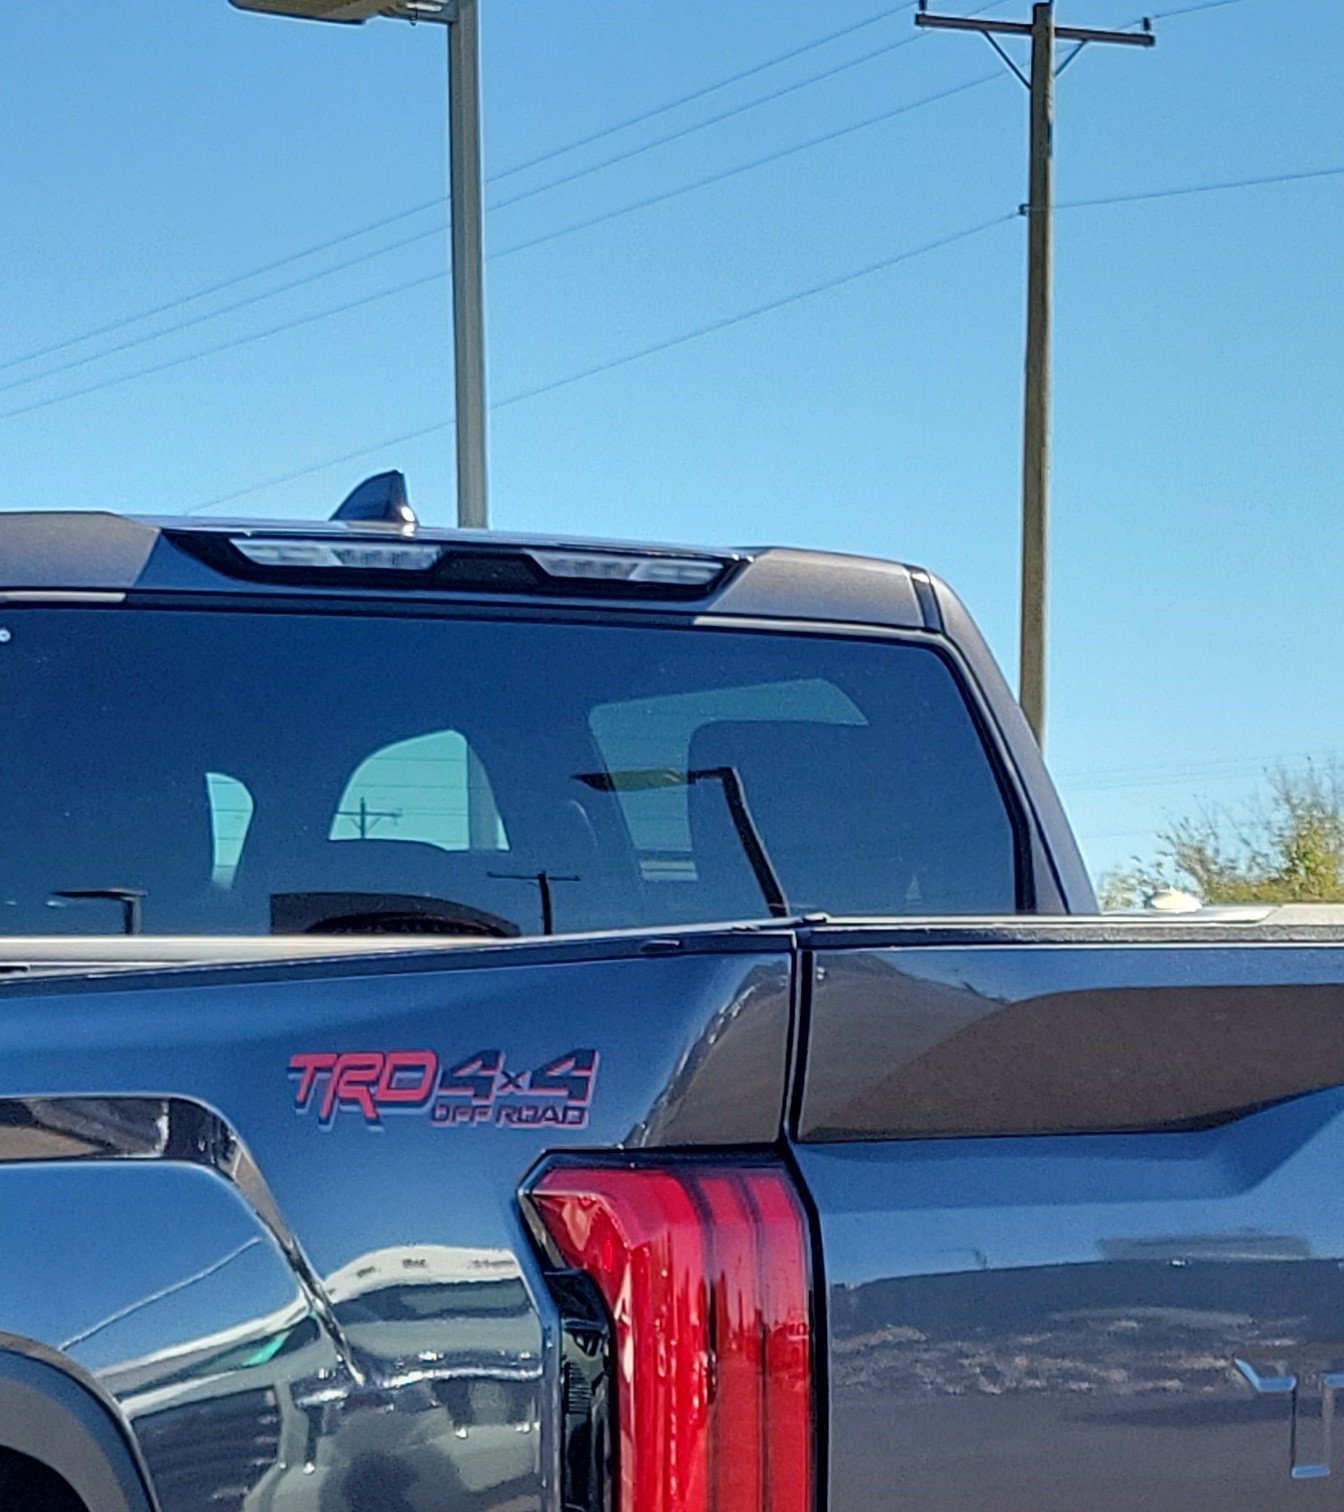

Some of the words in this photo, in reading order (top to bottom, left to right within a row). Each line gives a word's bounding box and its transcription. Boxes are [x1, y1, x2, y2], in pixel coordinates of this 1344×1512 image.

[288, 1050, 440, 1130] TRD
[436, 1050, 599, 1104] 4x4
[431, 1104, 489, 1127] OFF
[494, 1104, 588, 1128] ROAD
